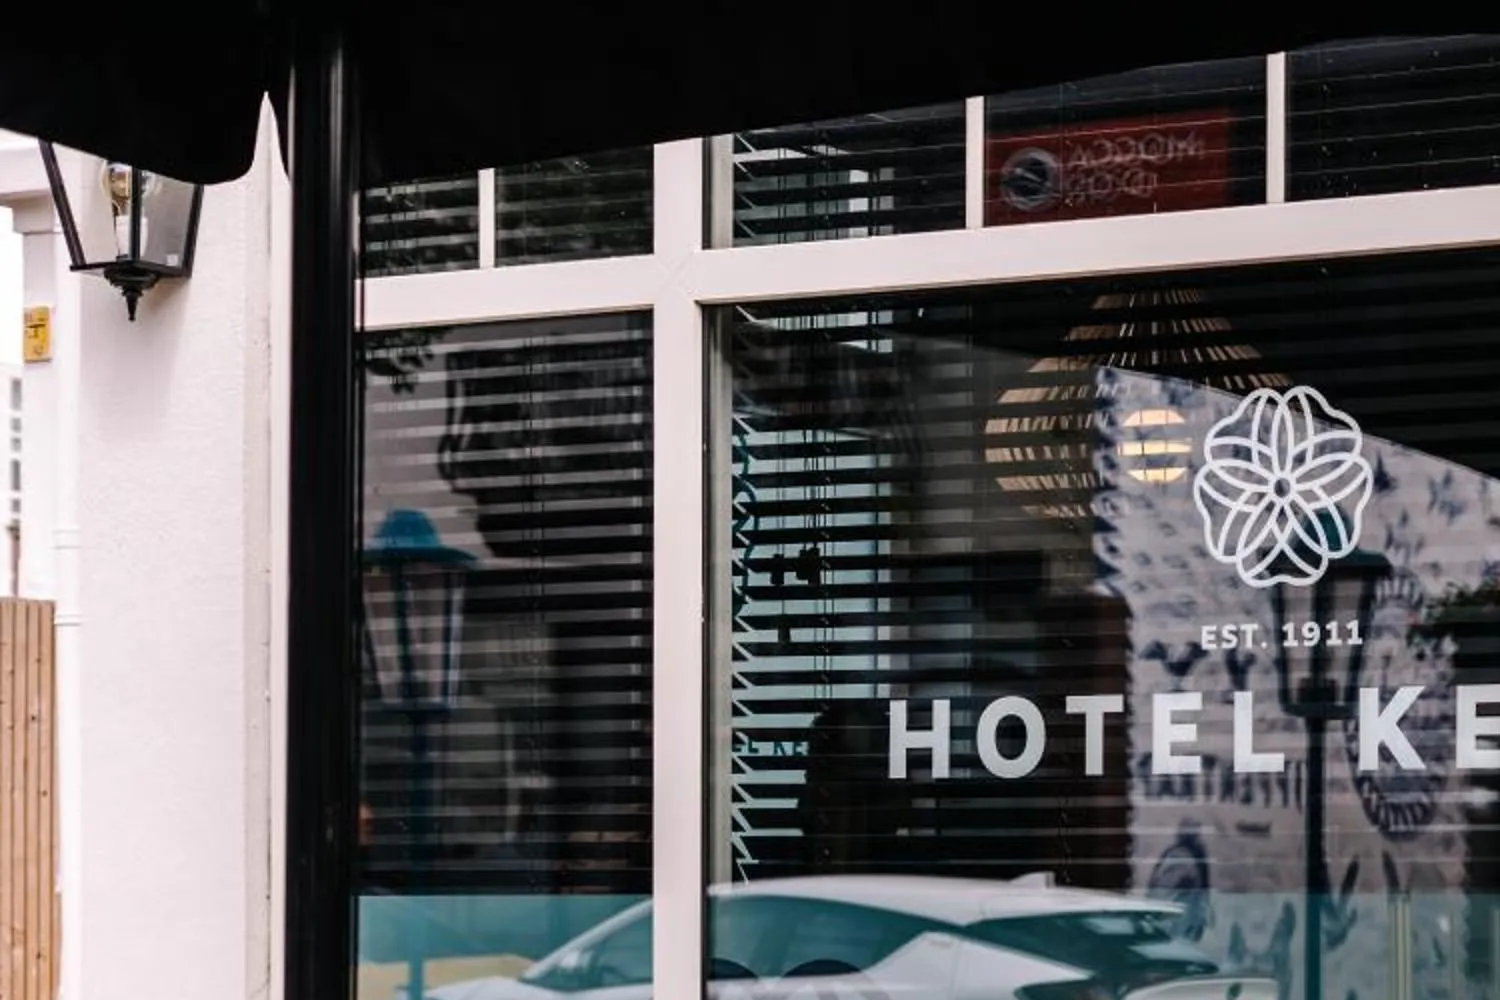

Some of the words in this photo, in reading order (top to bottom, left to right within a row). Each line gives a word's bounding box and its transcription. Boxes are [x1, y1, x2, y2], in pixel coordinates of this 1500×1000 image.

[1201, 623, 1267, 650] EST.
[1282, 619, 1363, 647] 1911
[888, 690, 1286, 779] HOTEL
